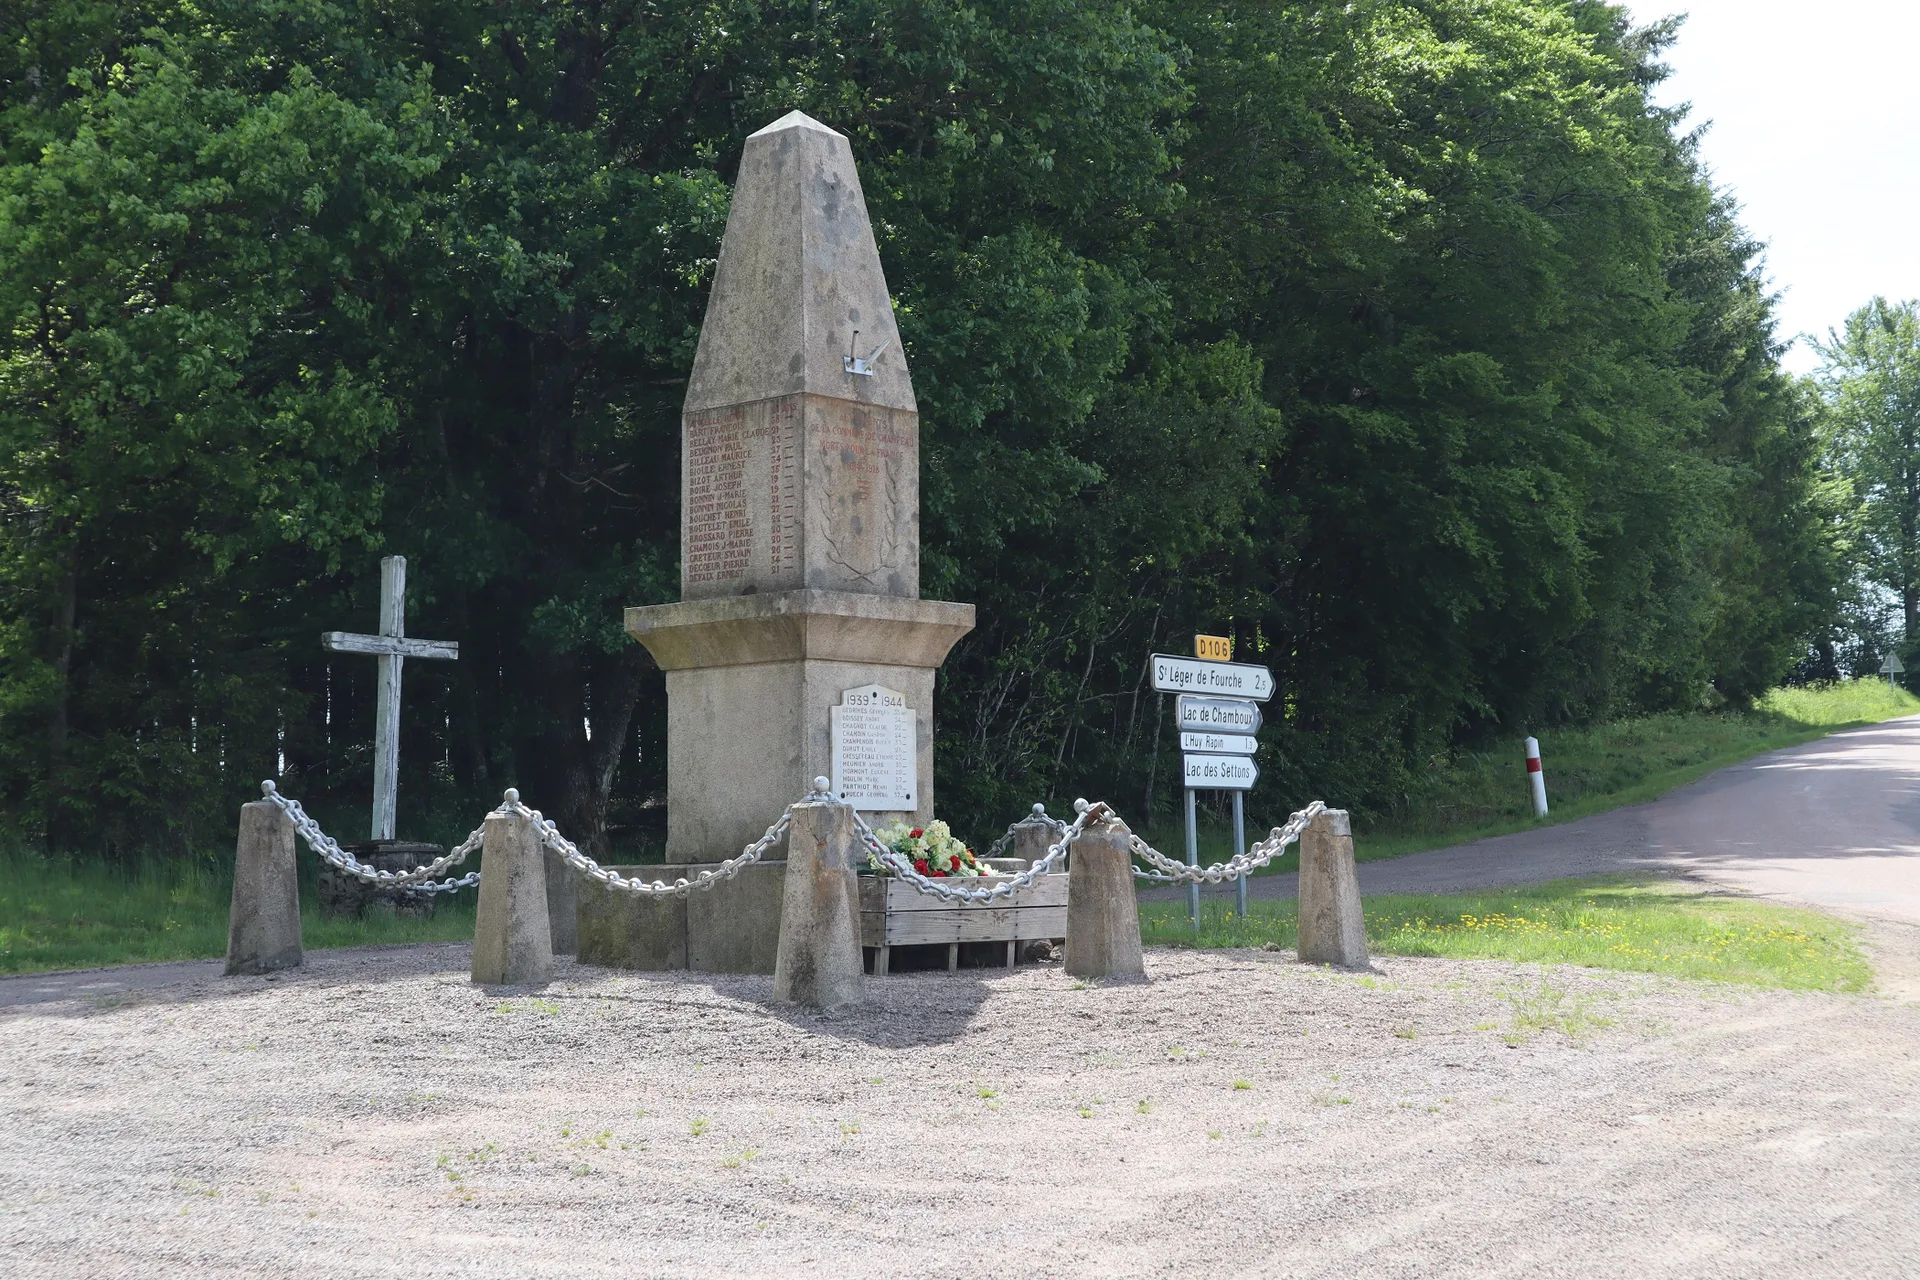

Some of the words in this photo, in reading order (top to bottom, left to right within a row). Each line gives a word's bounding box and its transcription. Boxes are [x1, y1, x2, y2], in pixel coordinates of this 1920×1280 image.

[718, 432, 739, 442] MARIE
[742, 428, 770, 439] CLAUDE
[725, 442, 742, 450] PAUL
[820, 440, 844, 450] MORTS
[722, 450, 752, 462] MAURICE
[718, 461, 746, 472] ERNEST
[690, 476, 711, 486] BIZOT
[714, 471, 743, 482] ARTHUR
[690, 485, 710, 495] BOIRE
[714, 480, 742, 492] JOSEPH
[716, 499, 746, 510] NICOLAS
[690, 512, 723, 524] BOUCHET
[725, 509, 746, 519] HENRI
[690, 522, 726, 533] BOUTELET
[730, 518, 751, 528] EMILE
[690, 532, 725, 543] BROSSARD
[729, 528, 753, 538] PIERRE
[689, 542, 719, 553] CHAMOIS
[724, 549, 751, 559] SYLVAIN
[723, 559, 749, 569] PIERRE
[717, 569, 744, 580] ERNEST
[1170, 666, 1193, 687] Léger
[1198, 670, 1206, 684] de
[1210, 670, 1242, 688] Fourche
[847, 695, 869, 705] 1939
[882, 696, 902, 707] 1944
[1184, 705, 1196, 720] Lac
[1200, 706, 1209, 721] de
[1212, 707, 1252, 724] Chamboux
[1206, 735, 1224, 750] Rapin
[1186, 762, 1200, 777] Lac
[1204, 763, 1218, 777] des
[1221, 762, 1250, 778] Settons
